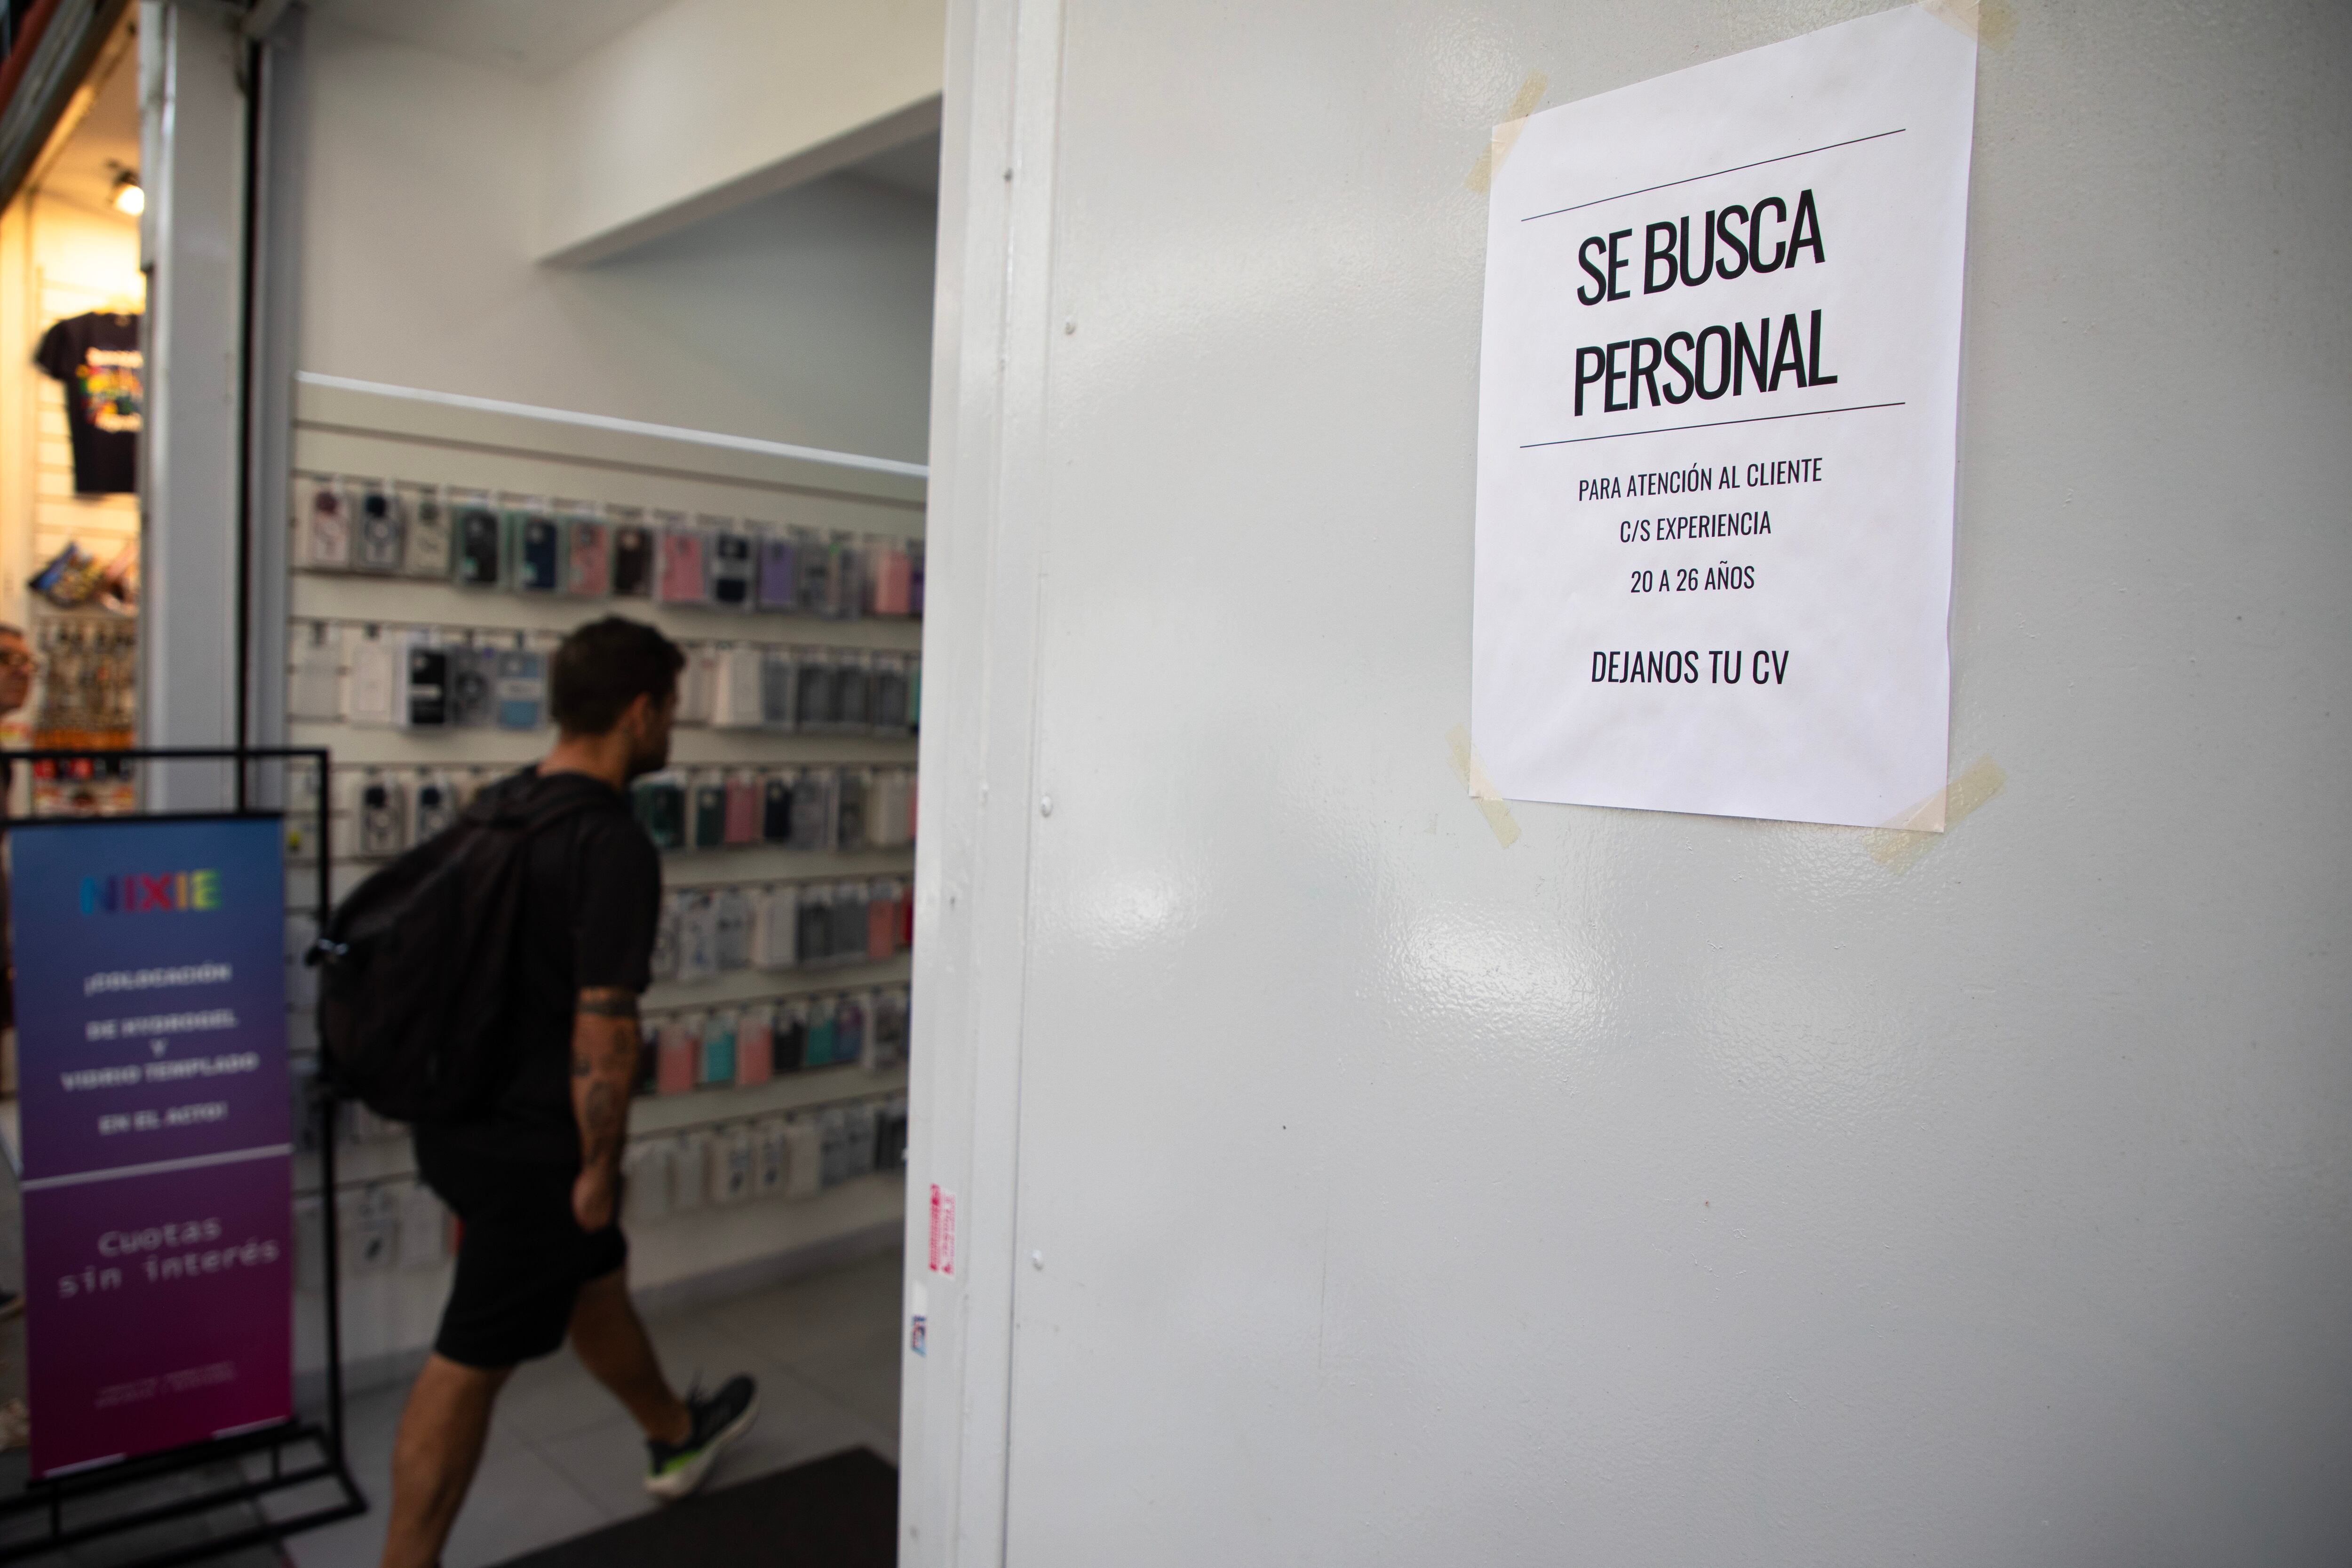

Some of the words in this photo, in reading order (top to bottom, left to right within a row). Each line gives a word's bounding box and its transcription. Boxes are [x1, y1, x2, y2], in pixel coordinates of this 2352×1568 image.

[1577, 228, 1633, 306] SE
[1643, 188, 1826, 295] BUSCA
[1574, 309, 1838, 417] PERSONAL
[1579, 476, 1621, 501] PARA
[1626, 462, 1713, 497] ATENCIÓN
[1718, 465, 1740, 490] AL
[1747, 457, 1823, 487] CLIENTE
[1620, 519, 1651, 543] C/S
[1656, 510, 1772, 541] EXPERIENCIA
[1630, 570, 1653, 593] 20
[1658, 569, 1670, 592] A
[1676, 568, 1699, 591] 26
[1704, 560, 1755, 590] AÑOS
[1591, 650, 1699, 684] DEJANOS
[1708, 650, 1742, 685] TU
[1752, 650, 1789, 685] CV
[79, 868, 223, 916] NIXIE
[86, 1020, 117, 1041] DE
[150, 1037, 168, 1058] Y
[61, 1065, 142, 1091] VIDRIO
[145, 1052, 260, 1082] TEMPLADO
[99, 1114, 131, 1135] EN
[134, 1110, 161, 1131] EL
[98, 1218, 222, 1258] Cuotas
[59, 1266, 122, 1299] sin
[145, 1237, 279, 1283] interés
